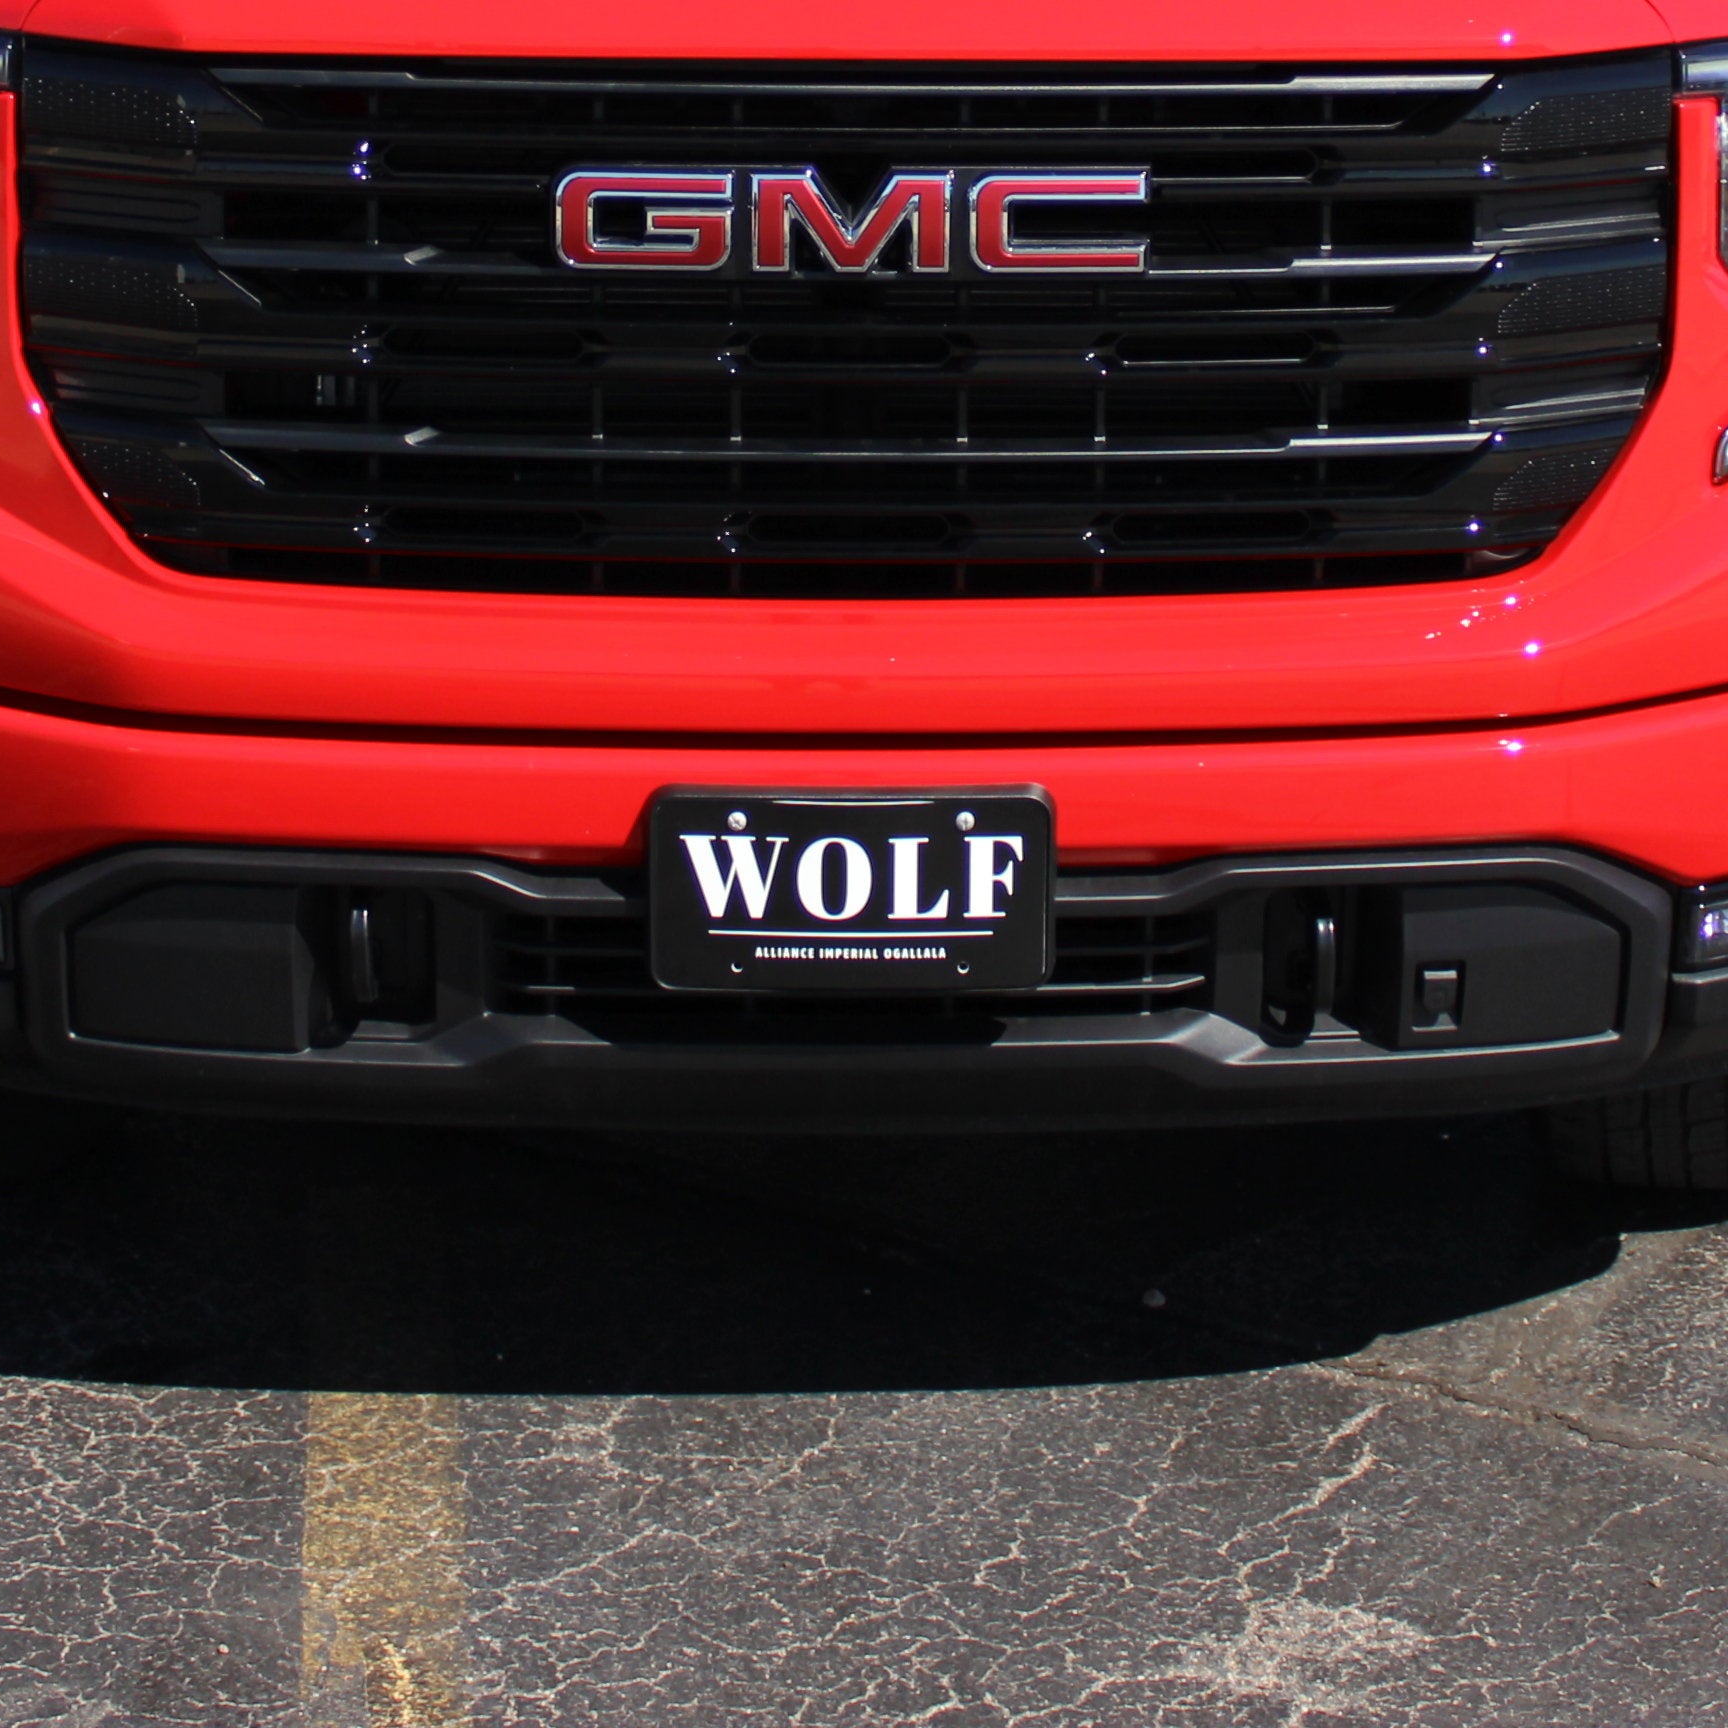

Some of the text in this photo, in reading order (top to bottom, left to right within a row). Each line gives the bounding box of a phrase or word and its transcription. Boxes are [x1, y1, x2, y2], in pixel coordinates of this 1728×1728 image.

[556, 169, 1150, 272] GMC
[679, 834, 1024, 921] WOLF
[754, 946, 947, 960] ALLIANCE IMPERIAL OGALLALA
